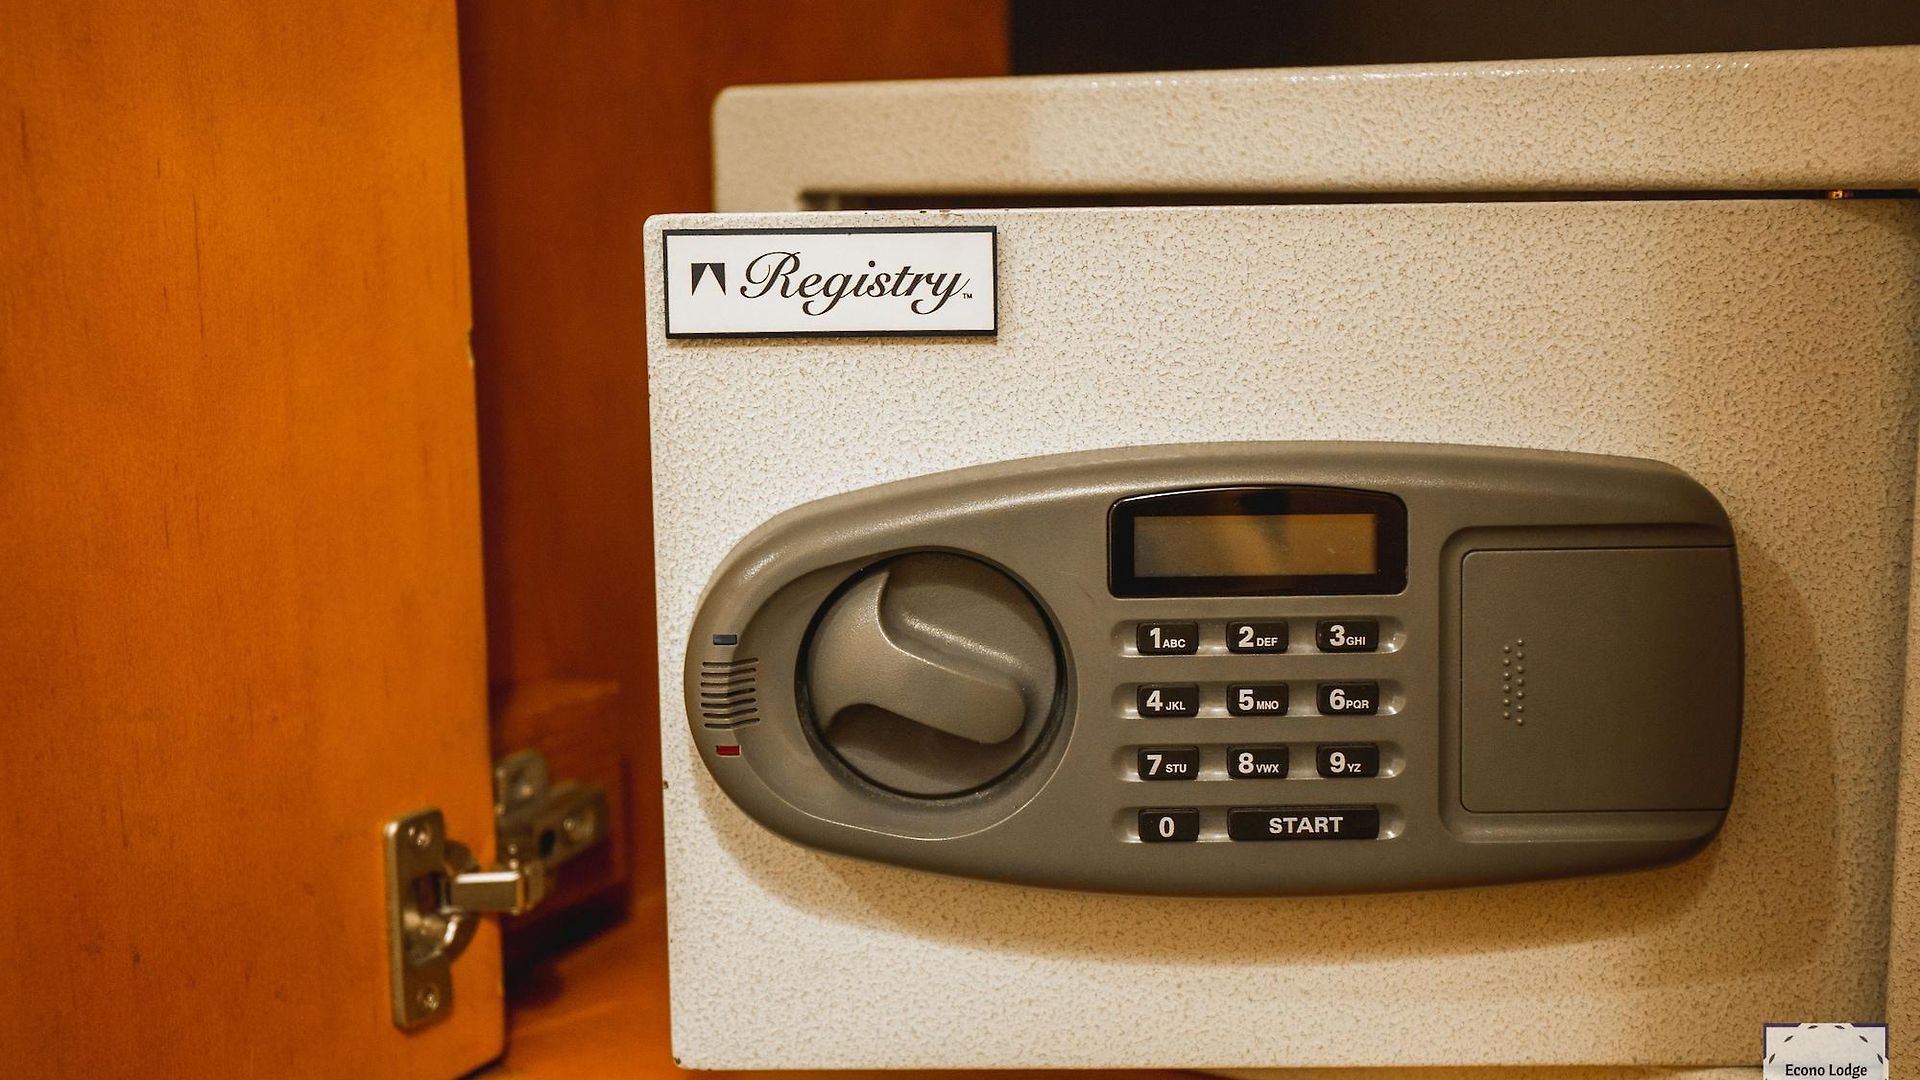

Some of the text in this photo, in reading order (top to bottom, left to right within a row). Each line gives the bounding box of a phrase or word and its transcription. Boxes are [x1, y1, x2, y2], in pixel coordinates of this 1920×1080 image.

[740, 251, 970, 316] Registry
[1149, 627, 1186, 649] 1 ABC
[1238, 626, 1278, 648] 2 DEF
[1329, 624, 1366, 647] 3 GHI
[1146, 690, 1186, 711] 4 JKL
[1238, 689, 1279, 711] 5 MNO
[1329, 688, 1369, 710] 6 PQR
[1146, 754, 1187, 776] 7 STU
[1238, 752, 1279, 774] 8 VWX
[1329, 752, 1361, 773] 9 YZ
[1158, 816, 1175, 838] 0
[1268, 816, 1344, 834] START
